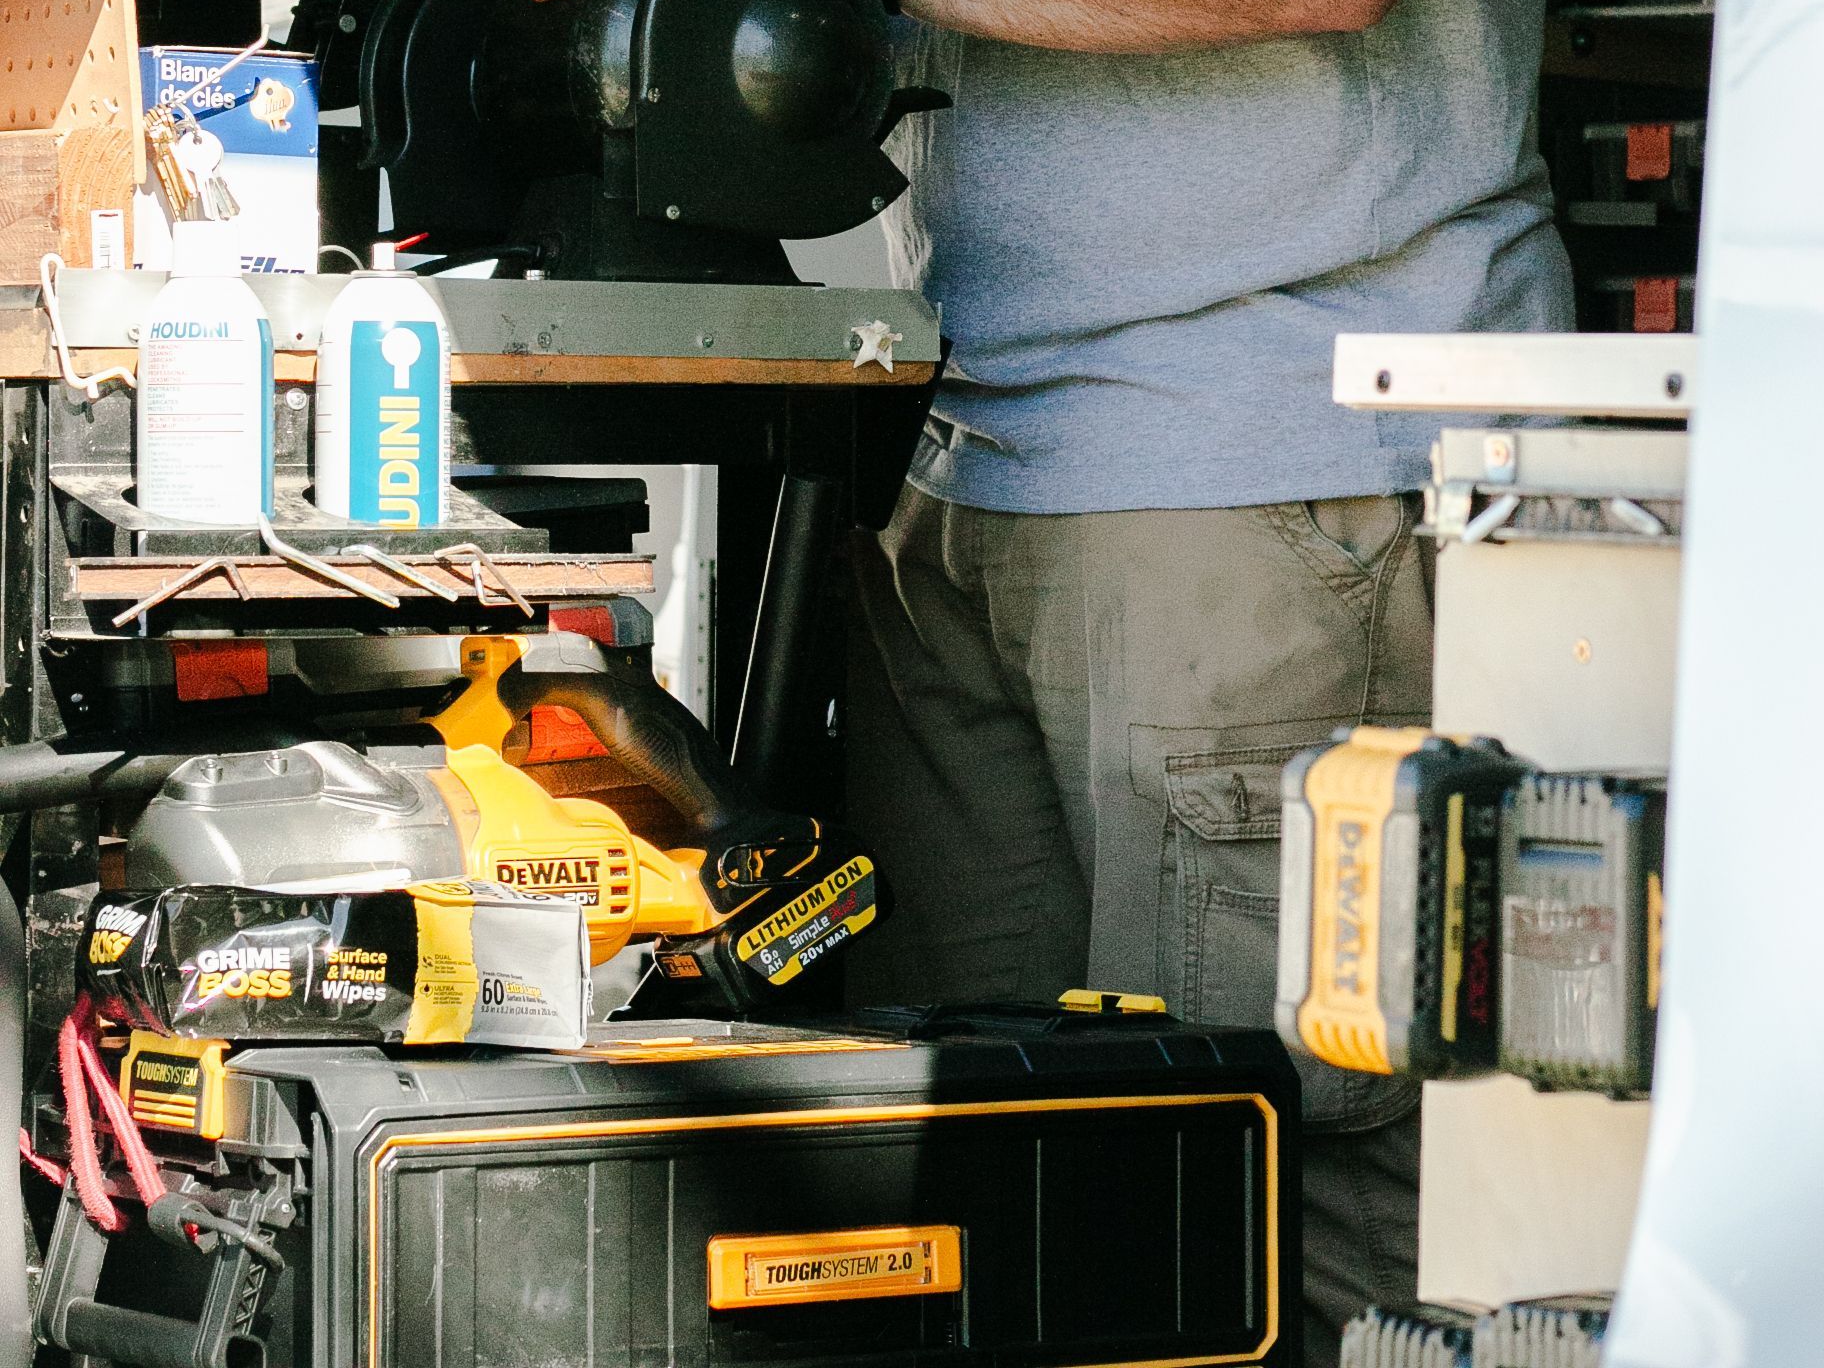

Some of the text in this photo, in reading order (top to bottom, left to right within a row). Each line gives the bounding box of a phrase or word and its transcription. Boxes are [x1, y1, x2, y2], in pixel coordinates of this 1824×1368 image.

[192, 85, 236, 109] clés
[150, 322, 229, 339] HOUDINI
[378, 396, 420, 530] UDINI
[746, 861, 863, 951] LITHIUM ION
[788, 915, 830, 950] Simple
[826, 926, 850, 948] MAX
[89, 931, 133, 964] BOSS
[197, 947, 291, 972] GRIME
[327, 947, 388, 965] Surface
[760, 948, 779, 965] 6.0
[326, 965, 386, 982] & Hand
[767, 958, 784, 976] AH
[198, 969, 292, 998] BOSS
[322, 980, 387, 1004] Wipes
[482, 978, 504, 1005] 60
[136, 1060, 198, 1086] TOUGHSYSTEM
[766, 1252, 913, 1284] TOUGHSYSTEM 2.0
